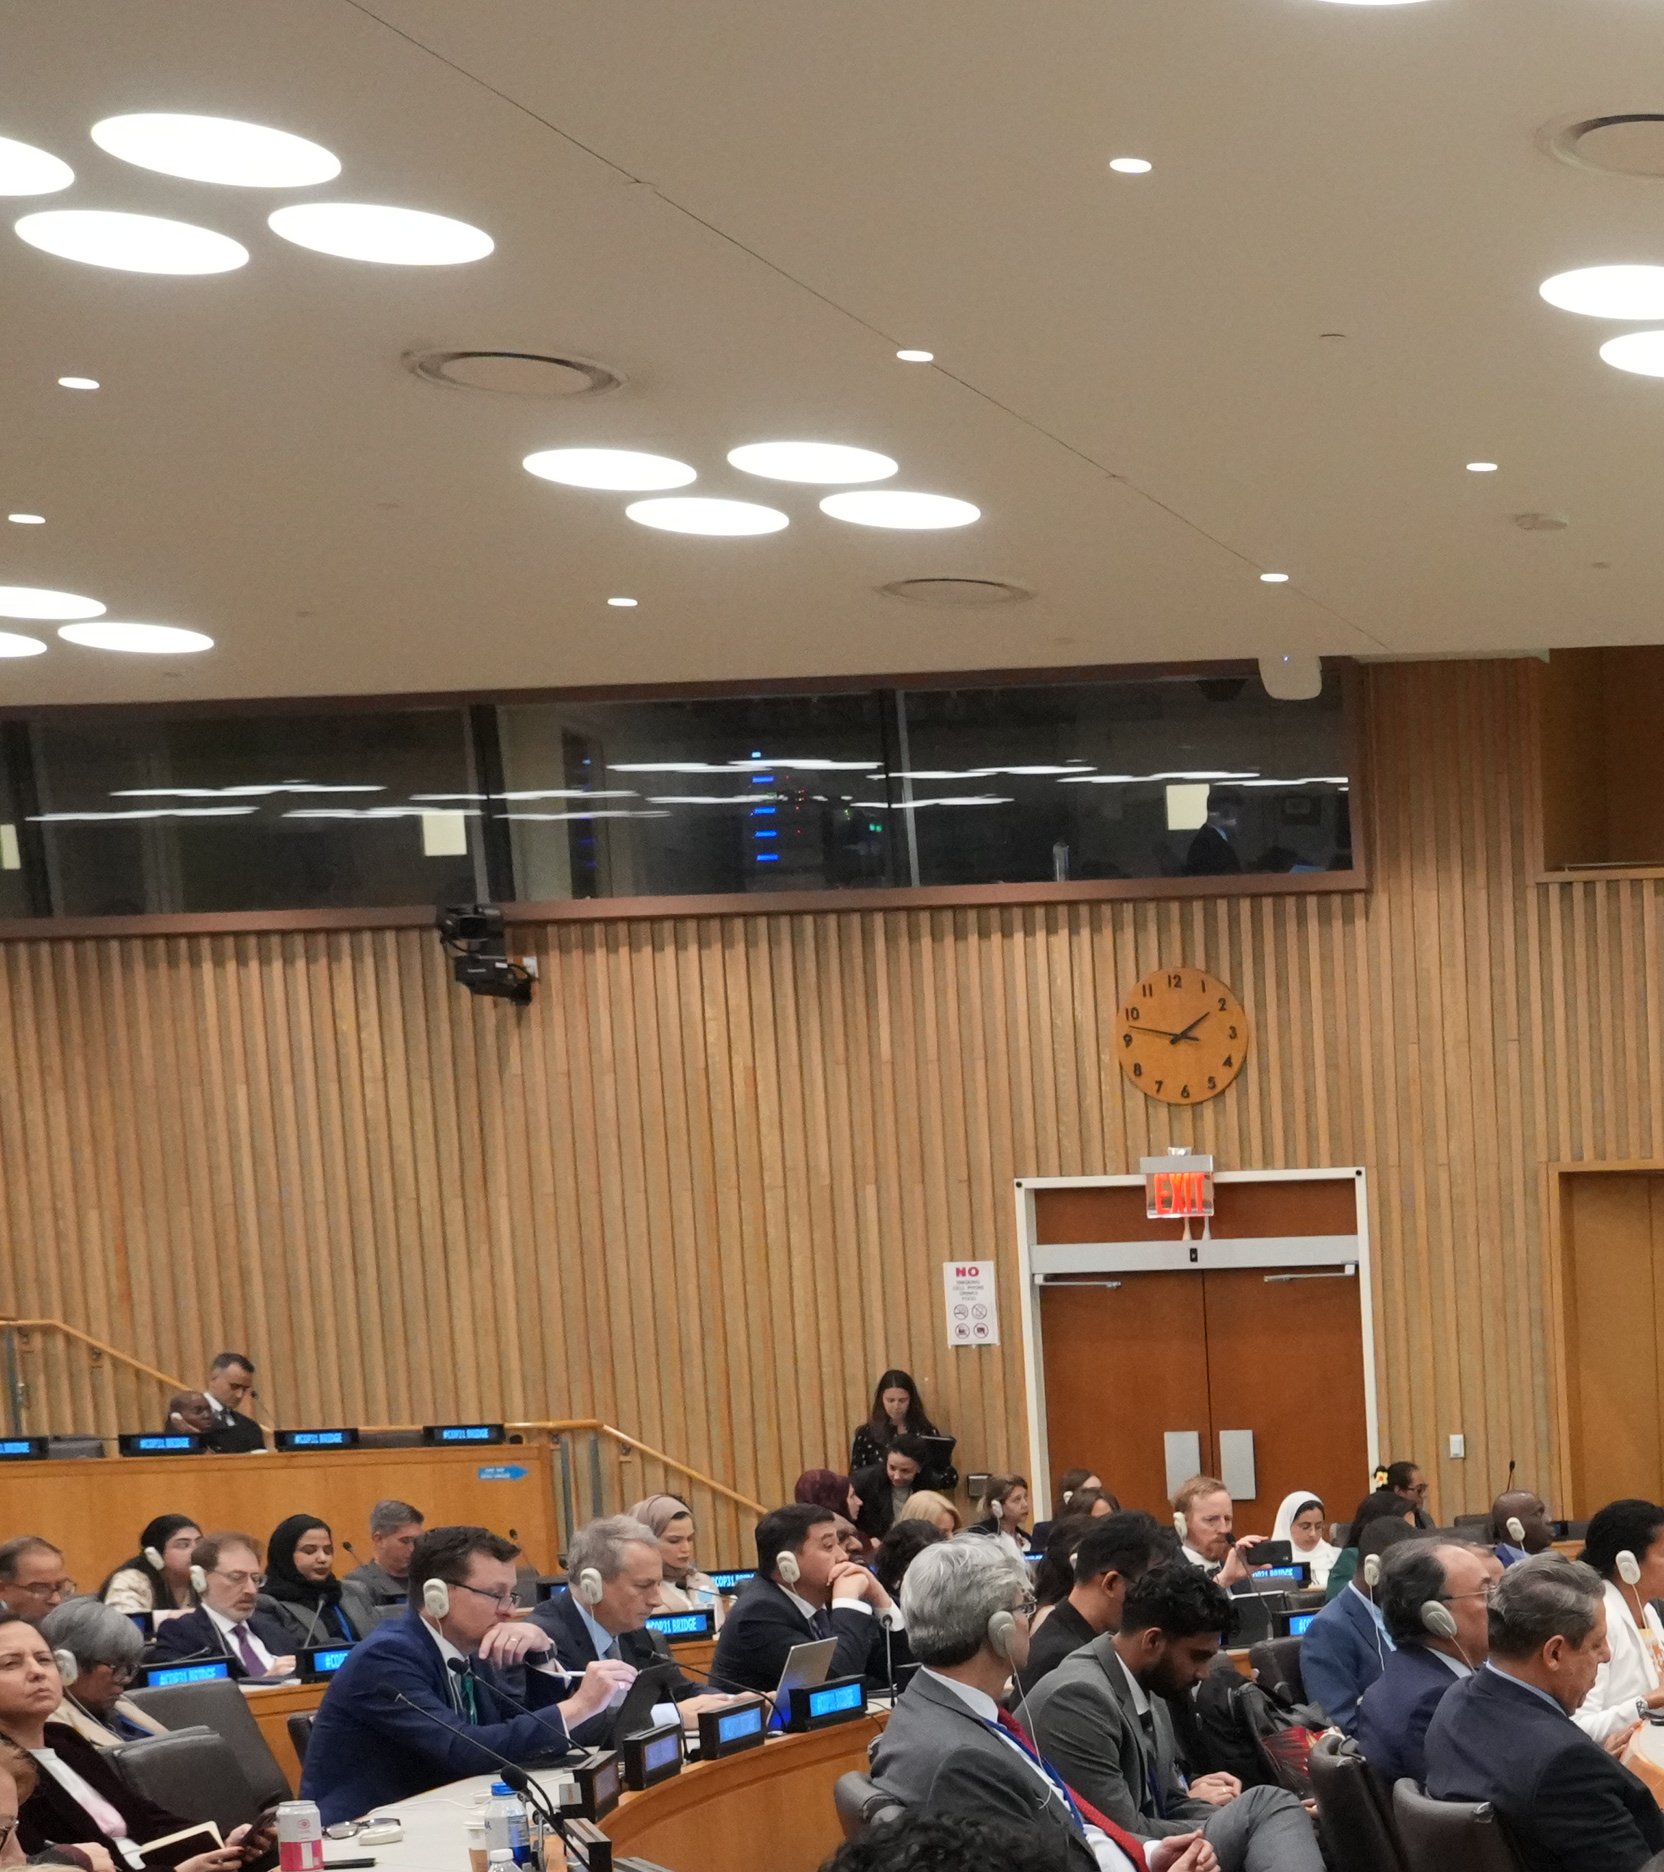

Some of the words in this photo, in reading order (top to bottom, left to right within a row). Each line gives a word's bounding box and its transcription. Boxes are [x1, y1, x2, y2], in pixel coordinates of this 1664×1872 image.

[1167, 974, 1182, 989] 12
[1142, 983, 1153, 998] 11
[1217, 997, 1228, 1012] 2
[1125, 1006, 1140, 1021] 10
[1229, 1025, 1238, 1040] 3
[1123, 1033, 1133, 1049] 9
[1222, 1053, 1233, 1068] 4
[1133, 1062, 1142, 1077] 8
[1155, 1080, 1163, 1094] 7
[1207, 1076, 1217, 1090] 5
[1181, 1084, 1190, 1099] 6
[1154, 1172, 1205, 1214] EXIT
[955, 1266, 979, 1277] NO
[673, 1618, 696, 1632] BRIDGE
